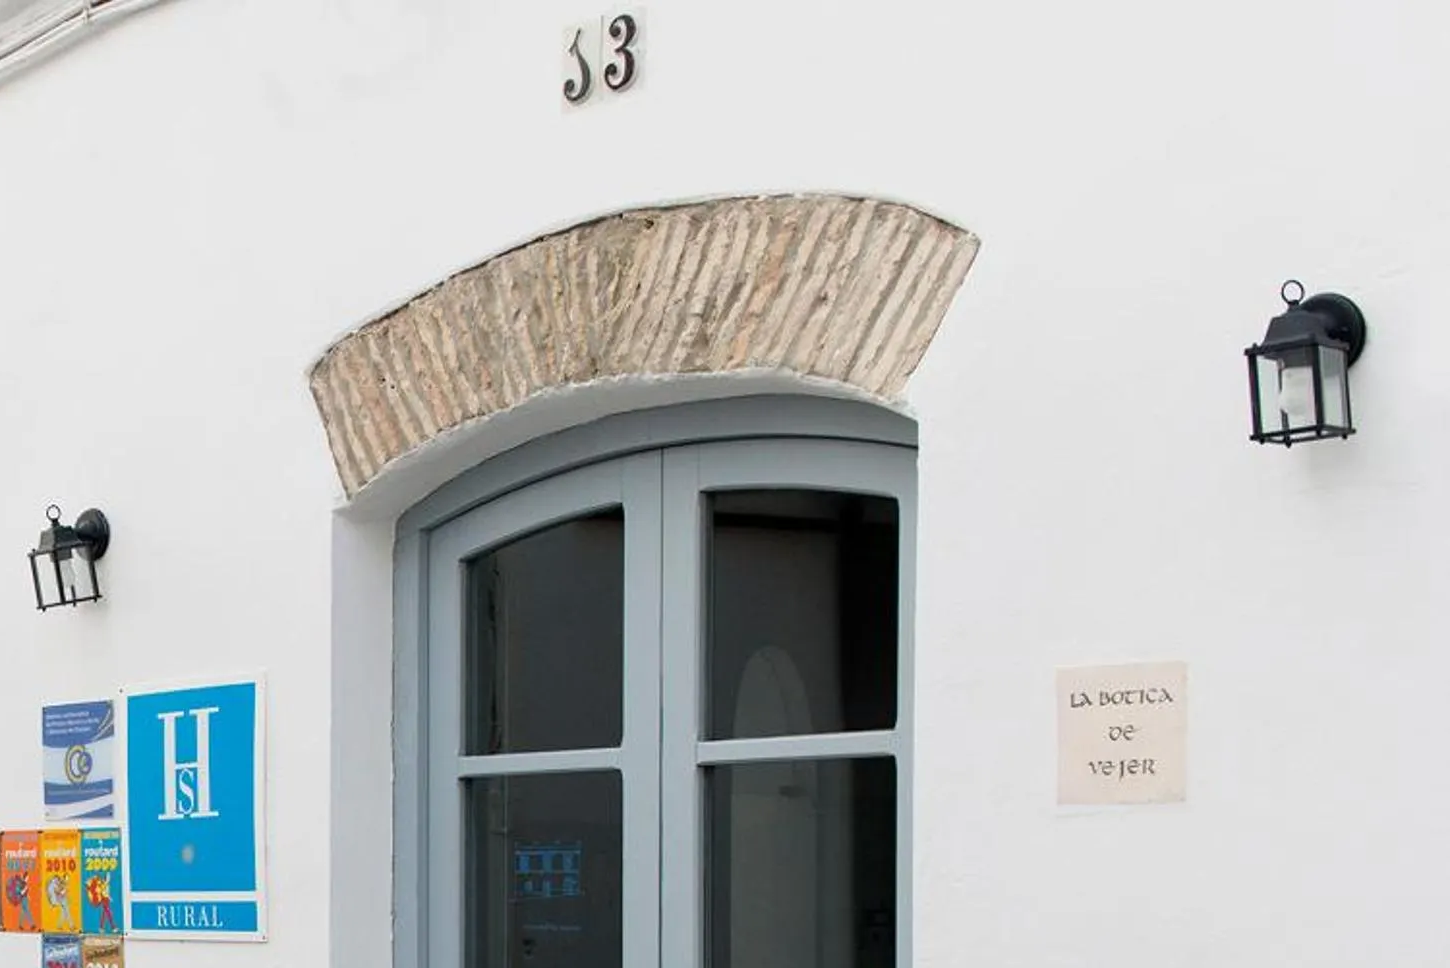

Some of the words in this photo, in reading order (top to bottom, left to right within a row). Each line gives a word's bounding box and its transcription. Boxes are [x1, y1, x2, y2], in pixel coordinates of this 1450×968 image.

[1070, 691, 1092, 708] LA
[1099, 687, 1174, 706] BOTICA
[46, 859, 76, 872] 2010
[85, 857, 118, 871] 2009
[156, 905, 223, 927] RURAL
